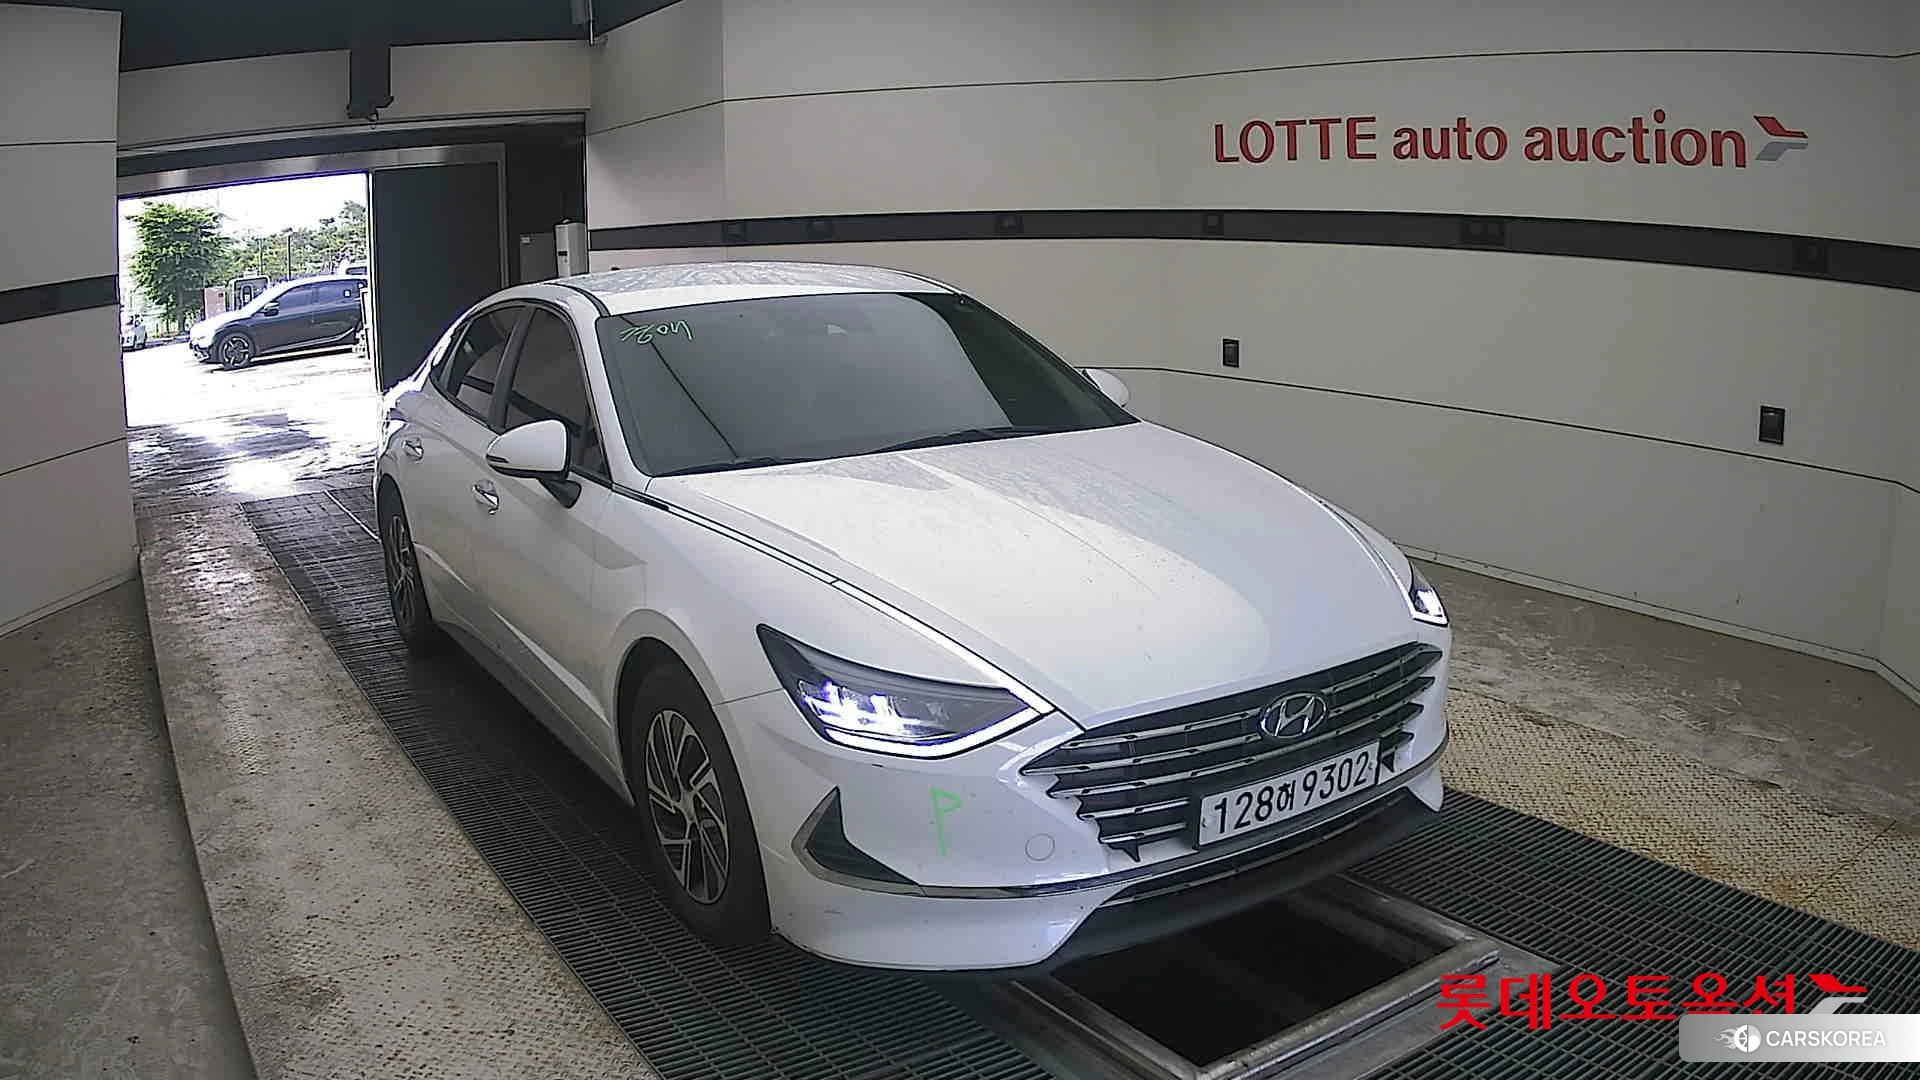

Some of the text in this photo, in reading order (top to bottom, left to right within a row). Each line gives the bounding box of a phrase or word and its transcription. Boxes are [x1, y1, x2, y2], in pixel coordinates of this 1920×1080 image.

[1214, 110, 1747, 168] LOTTE auto auction
